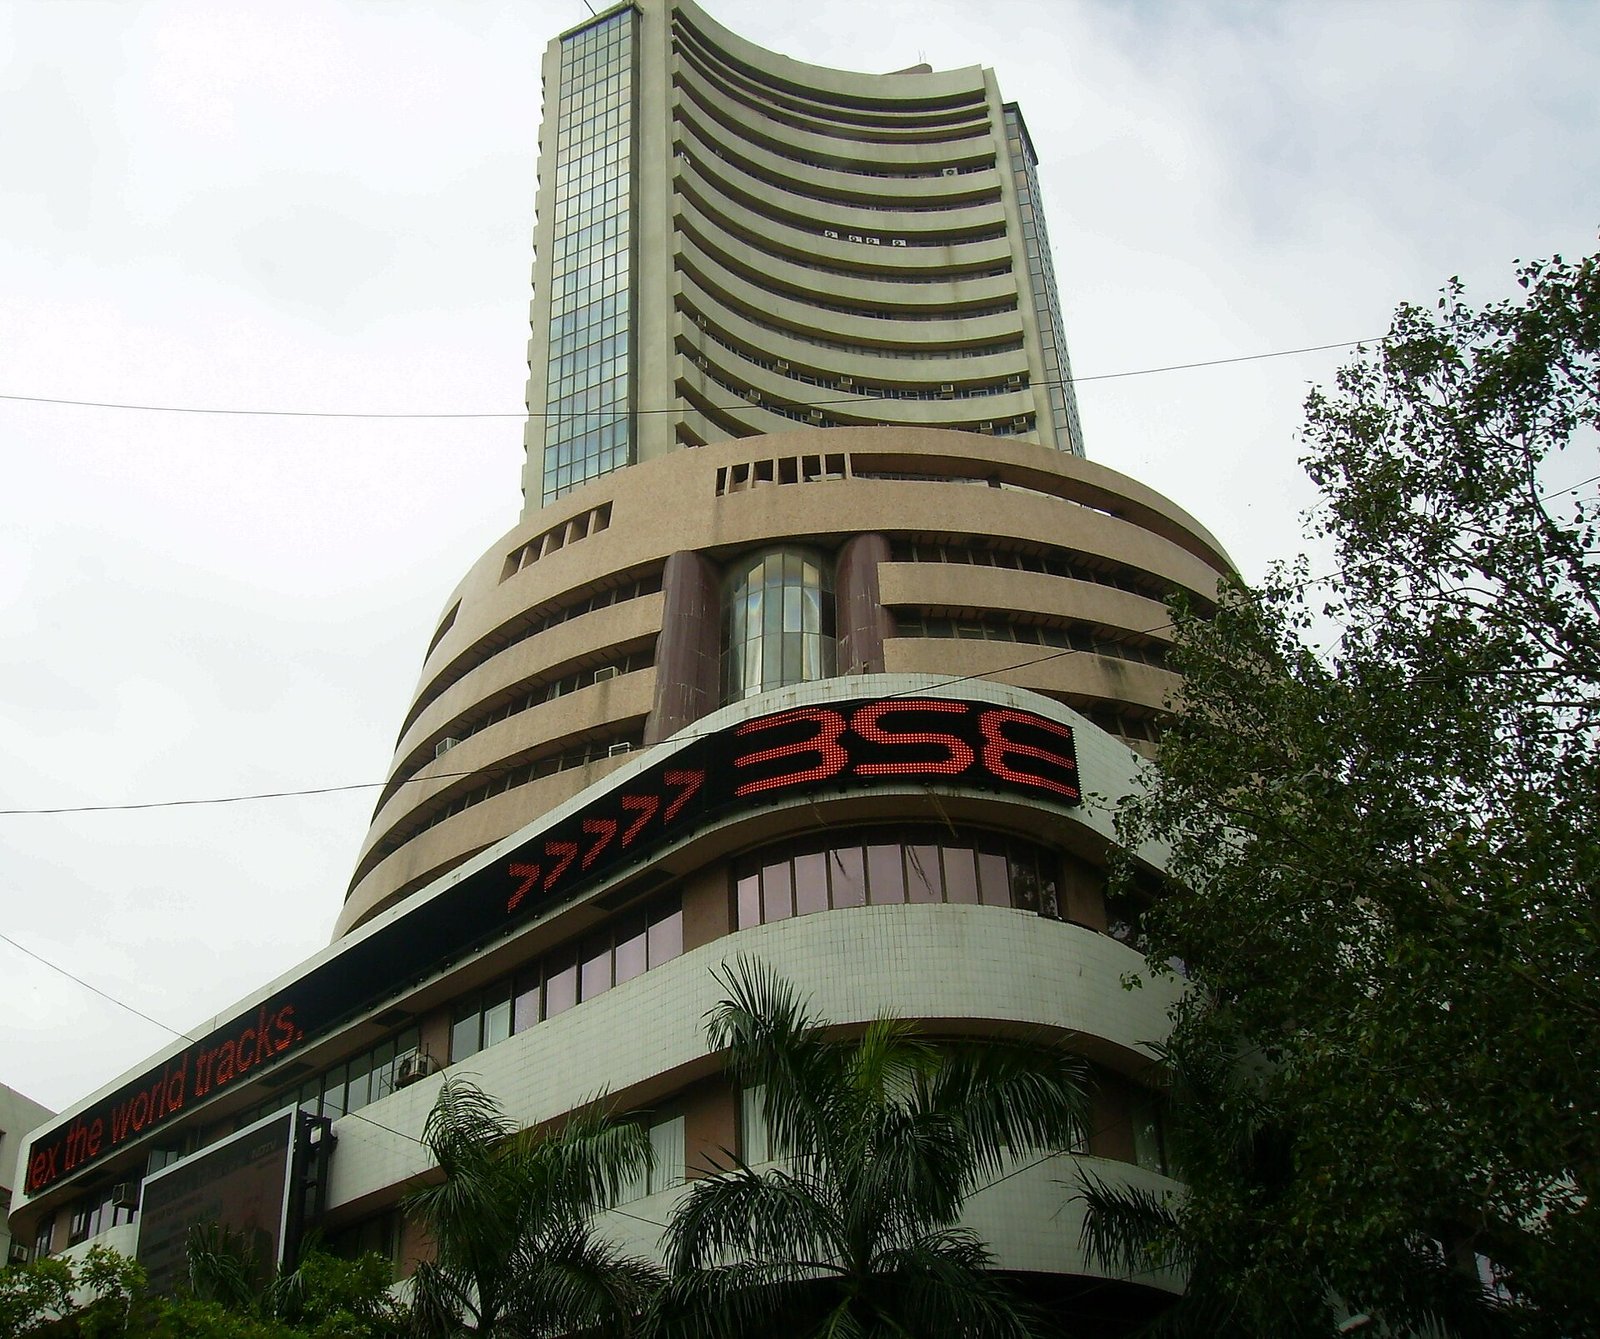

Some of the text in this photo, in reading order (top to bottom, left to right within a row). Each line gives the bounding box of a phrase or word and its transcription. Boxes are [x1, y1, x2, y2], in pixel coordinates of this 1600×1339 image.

[64, 1114, 105, 1171] the
[111, 1053, 189, 1143] world
[193, 1003, 304, 1096] tracks.
